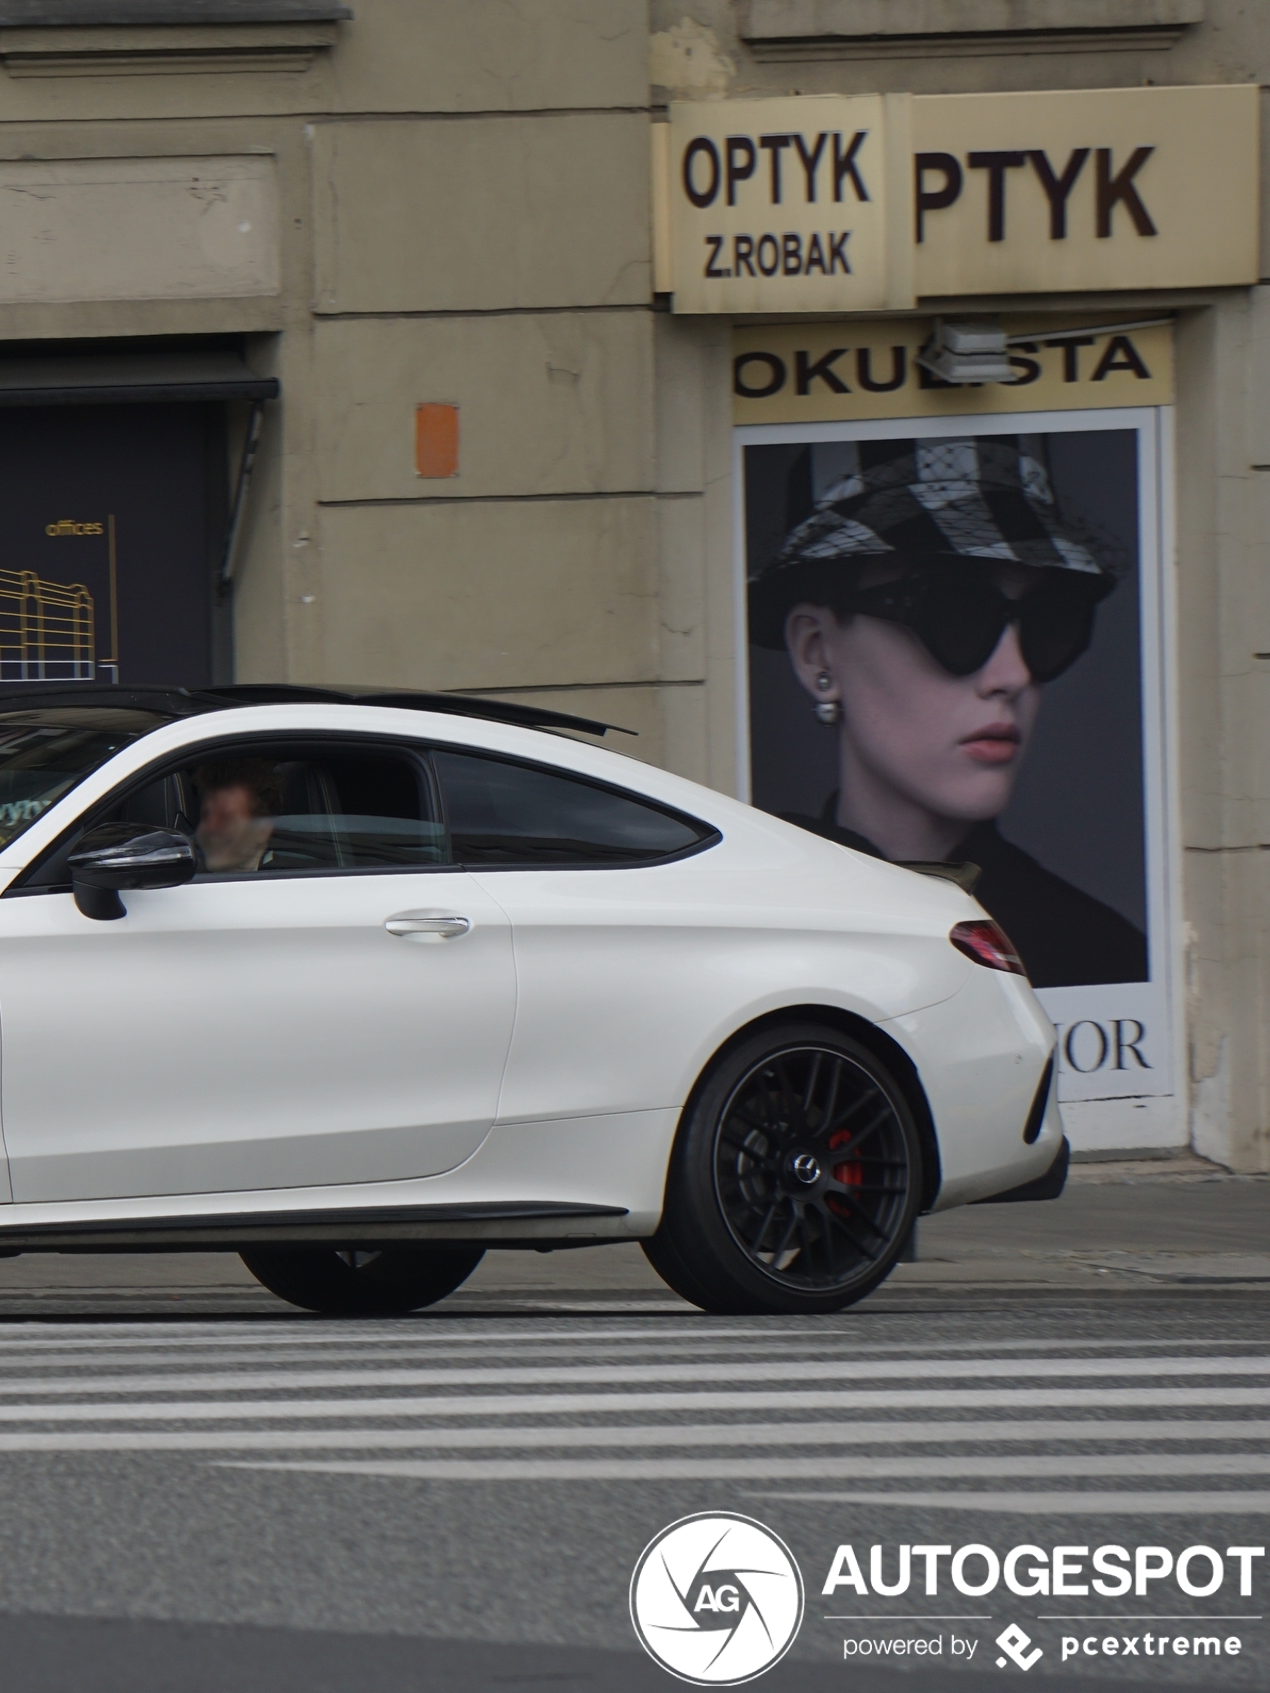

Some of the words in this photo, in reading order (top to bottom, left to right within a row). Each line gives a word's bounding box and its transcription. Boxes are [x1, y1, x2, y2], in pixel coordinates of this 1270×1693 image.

[682, 129, 871, 209] OPTYK
[705, 231, 852, 278] Z.ROBAK
[45, 519, 104, 536] offices
[1053, 1019, 1154, 1074] OR
